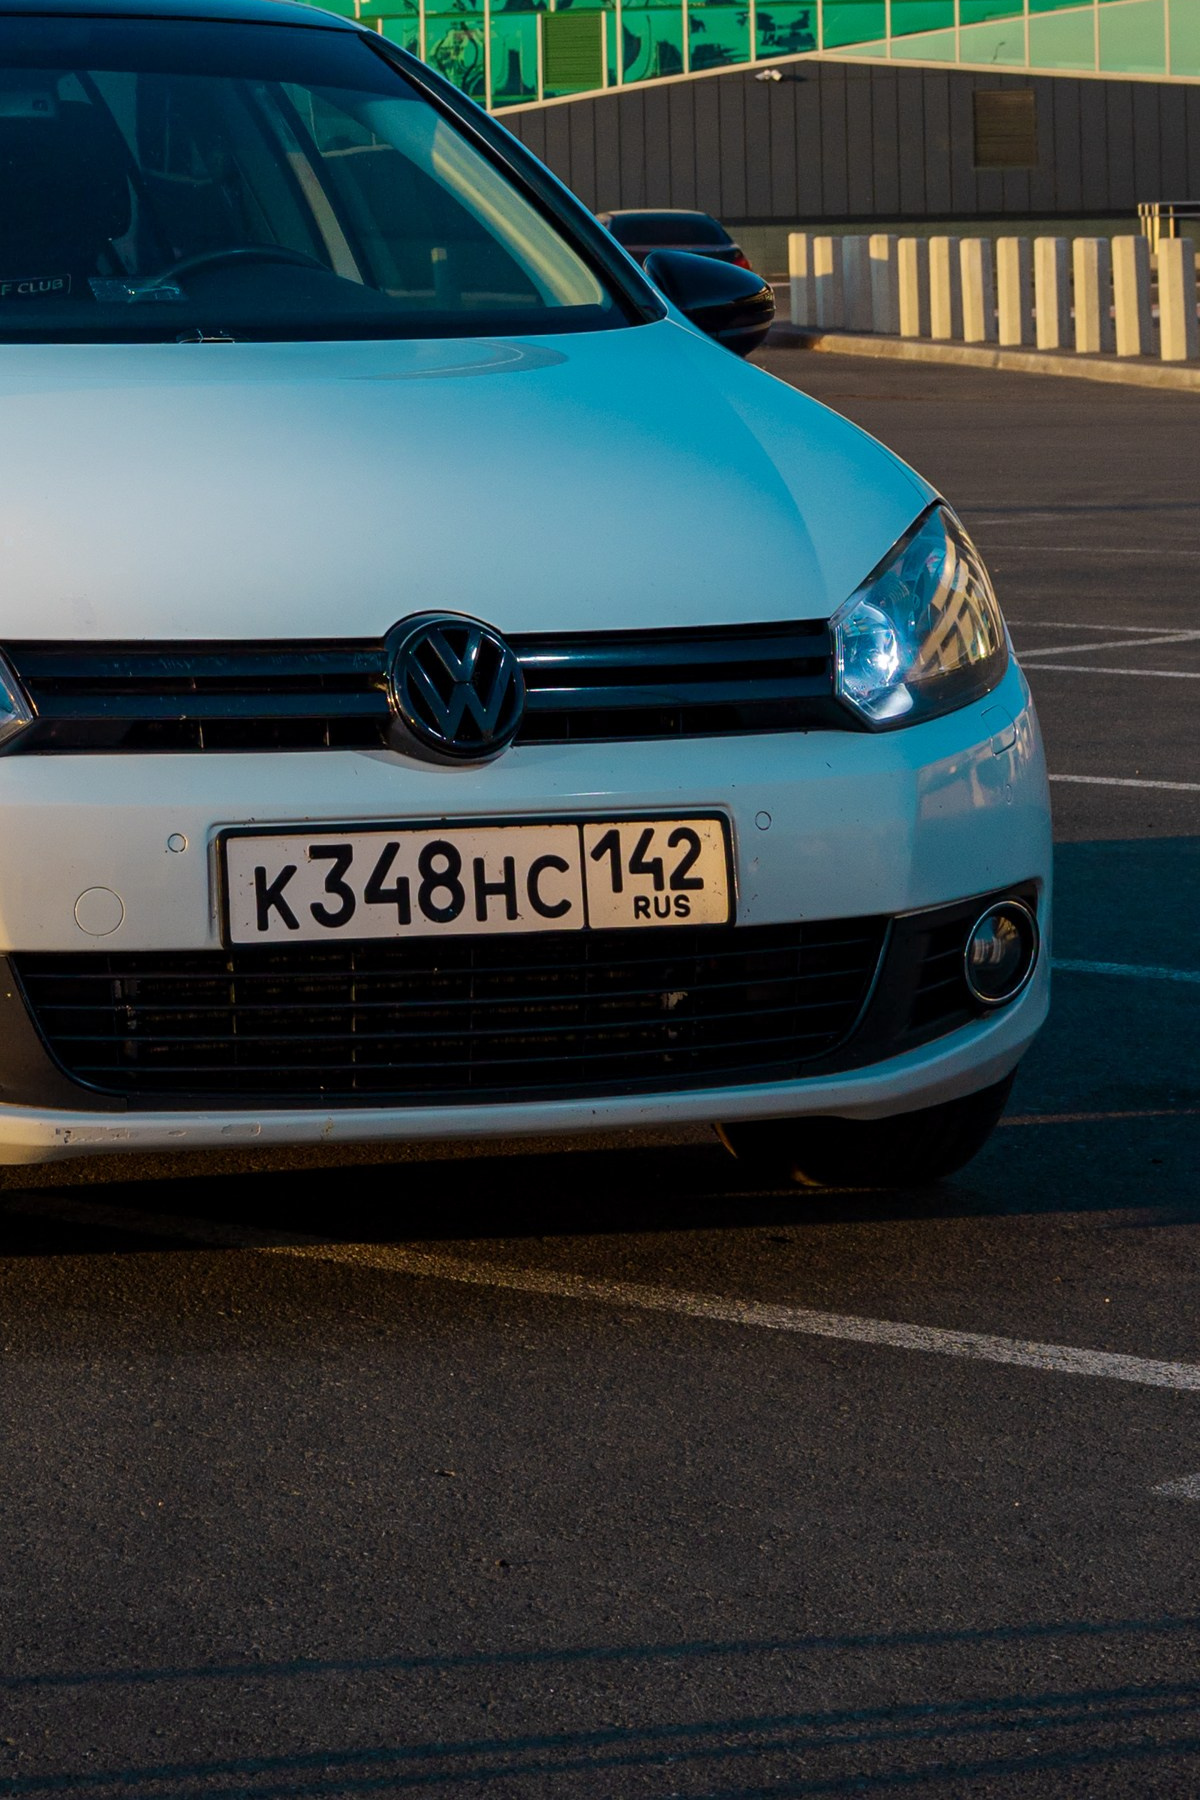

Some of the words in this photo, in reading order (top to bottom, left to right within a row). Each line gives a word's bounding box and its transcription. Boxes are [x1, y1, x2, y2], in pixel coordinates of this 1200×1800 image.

[17, 279, 63, 294] CLUB
[590, 826, 705, 893] 142
[633, 894, 692, 919] RUS
